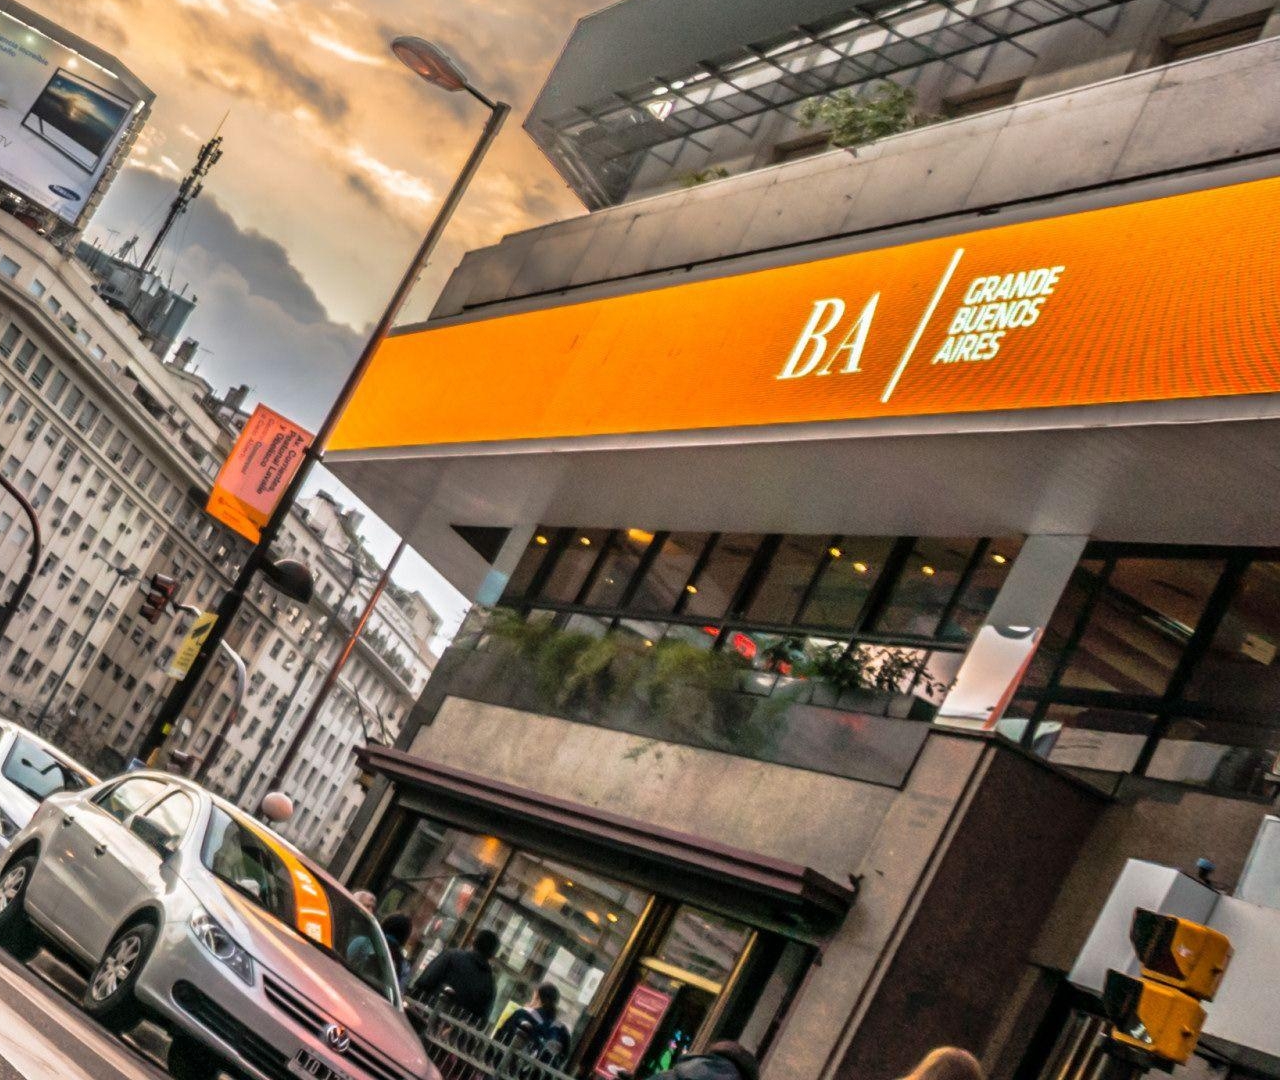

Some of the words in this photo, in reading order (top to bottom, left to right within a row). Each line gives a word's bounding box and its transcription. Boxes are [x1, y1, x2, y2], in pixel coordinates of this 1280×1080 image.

[963, 265, 1066, 306] GRANDE
[776, 291, 880, 380] BA
[948, 297, 1046, 336] BUENOS
[932, 331, 1006, 365] AIRES
